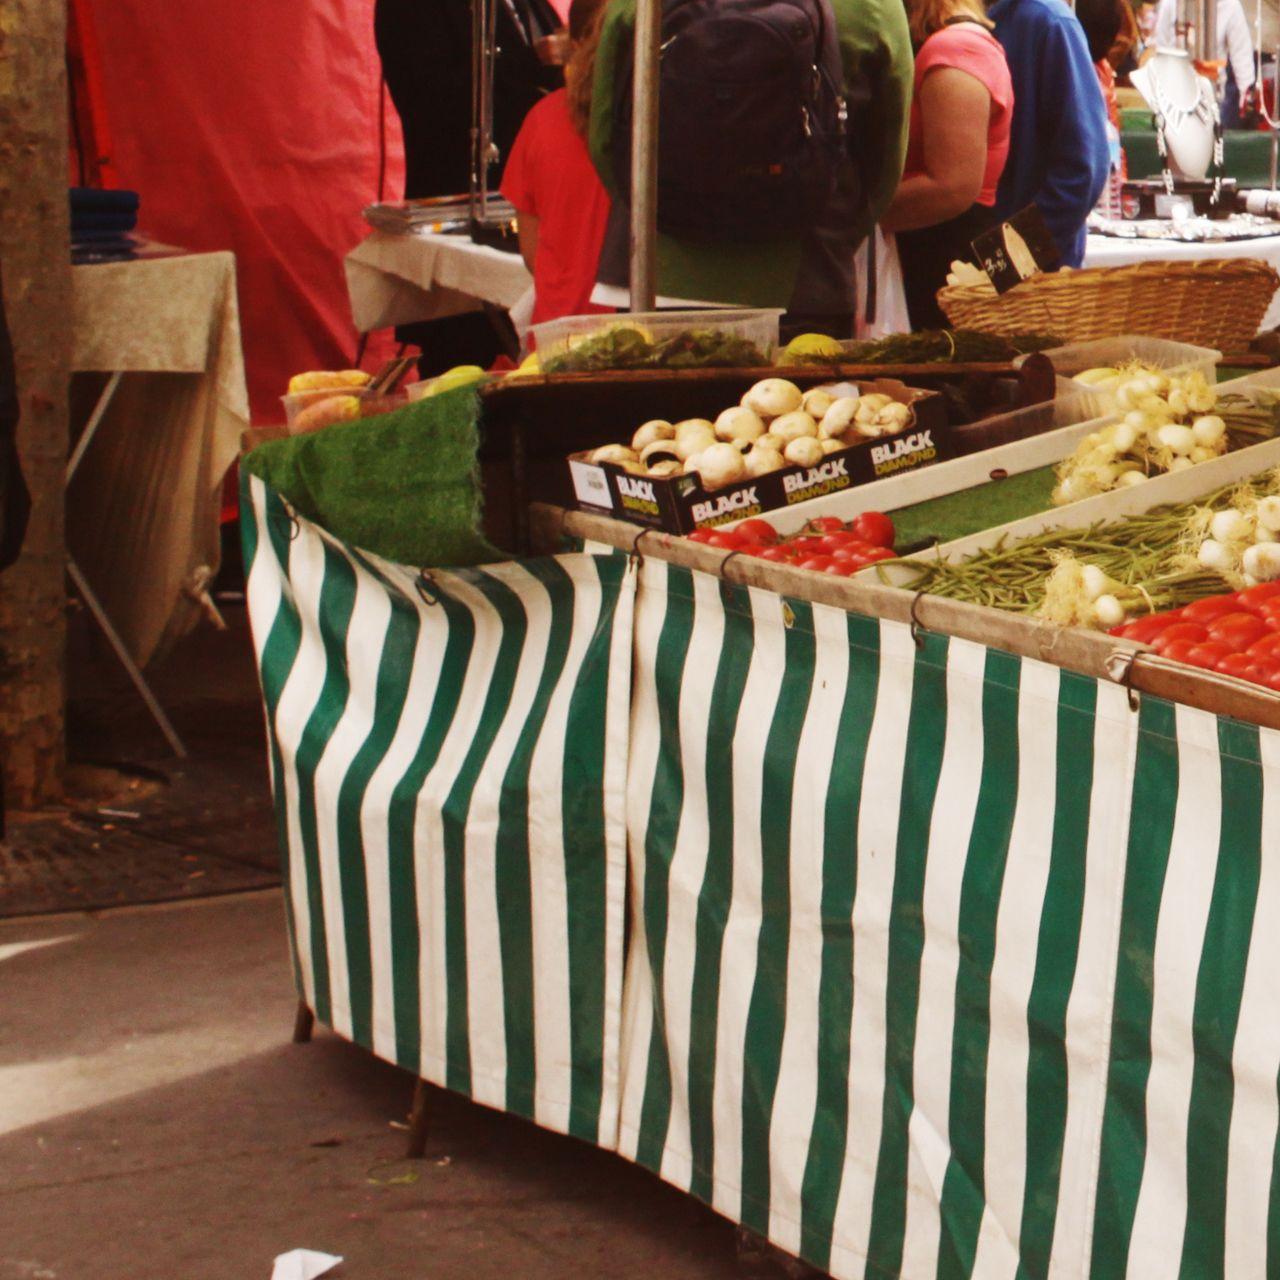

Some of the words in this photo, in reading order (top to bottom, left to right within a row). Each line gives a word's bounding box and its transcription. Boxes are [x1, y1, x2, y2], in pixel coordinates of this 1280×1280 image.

[871, 430, 935, 465] BLACK
[783, 457, 848, 494] BLACK
[691, 486, 760, 522] BLACK
